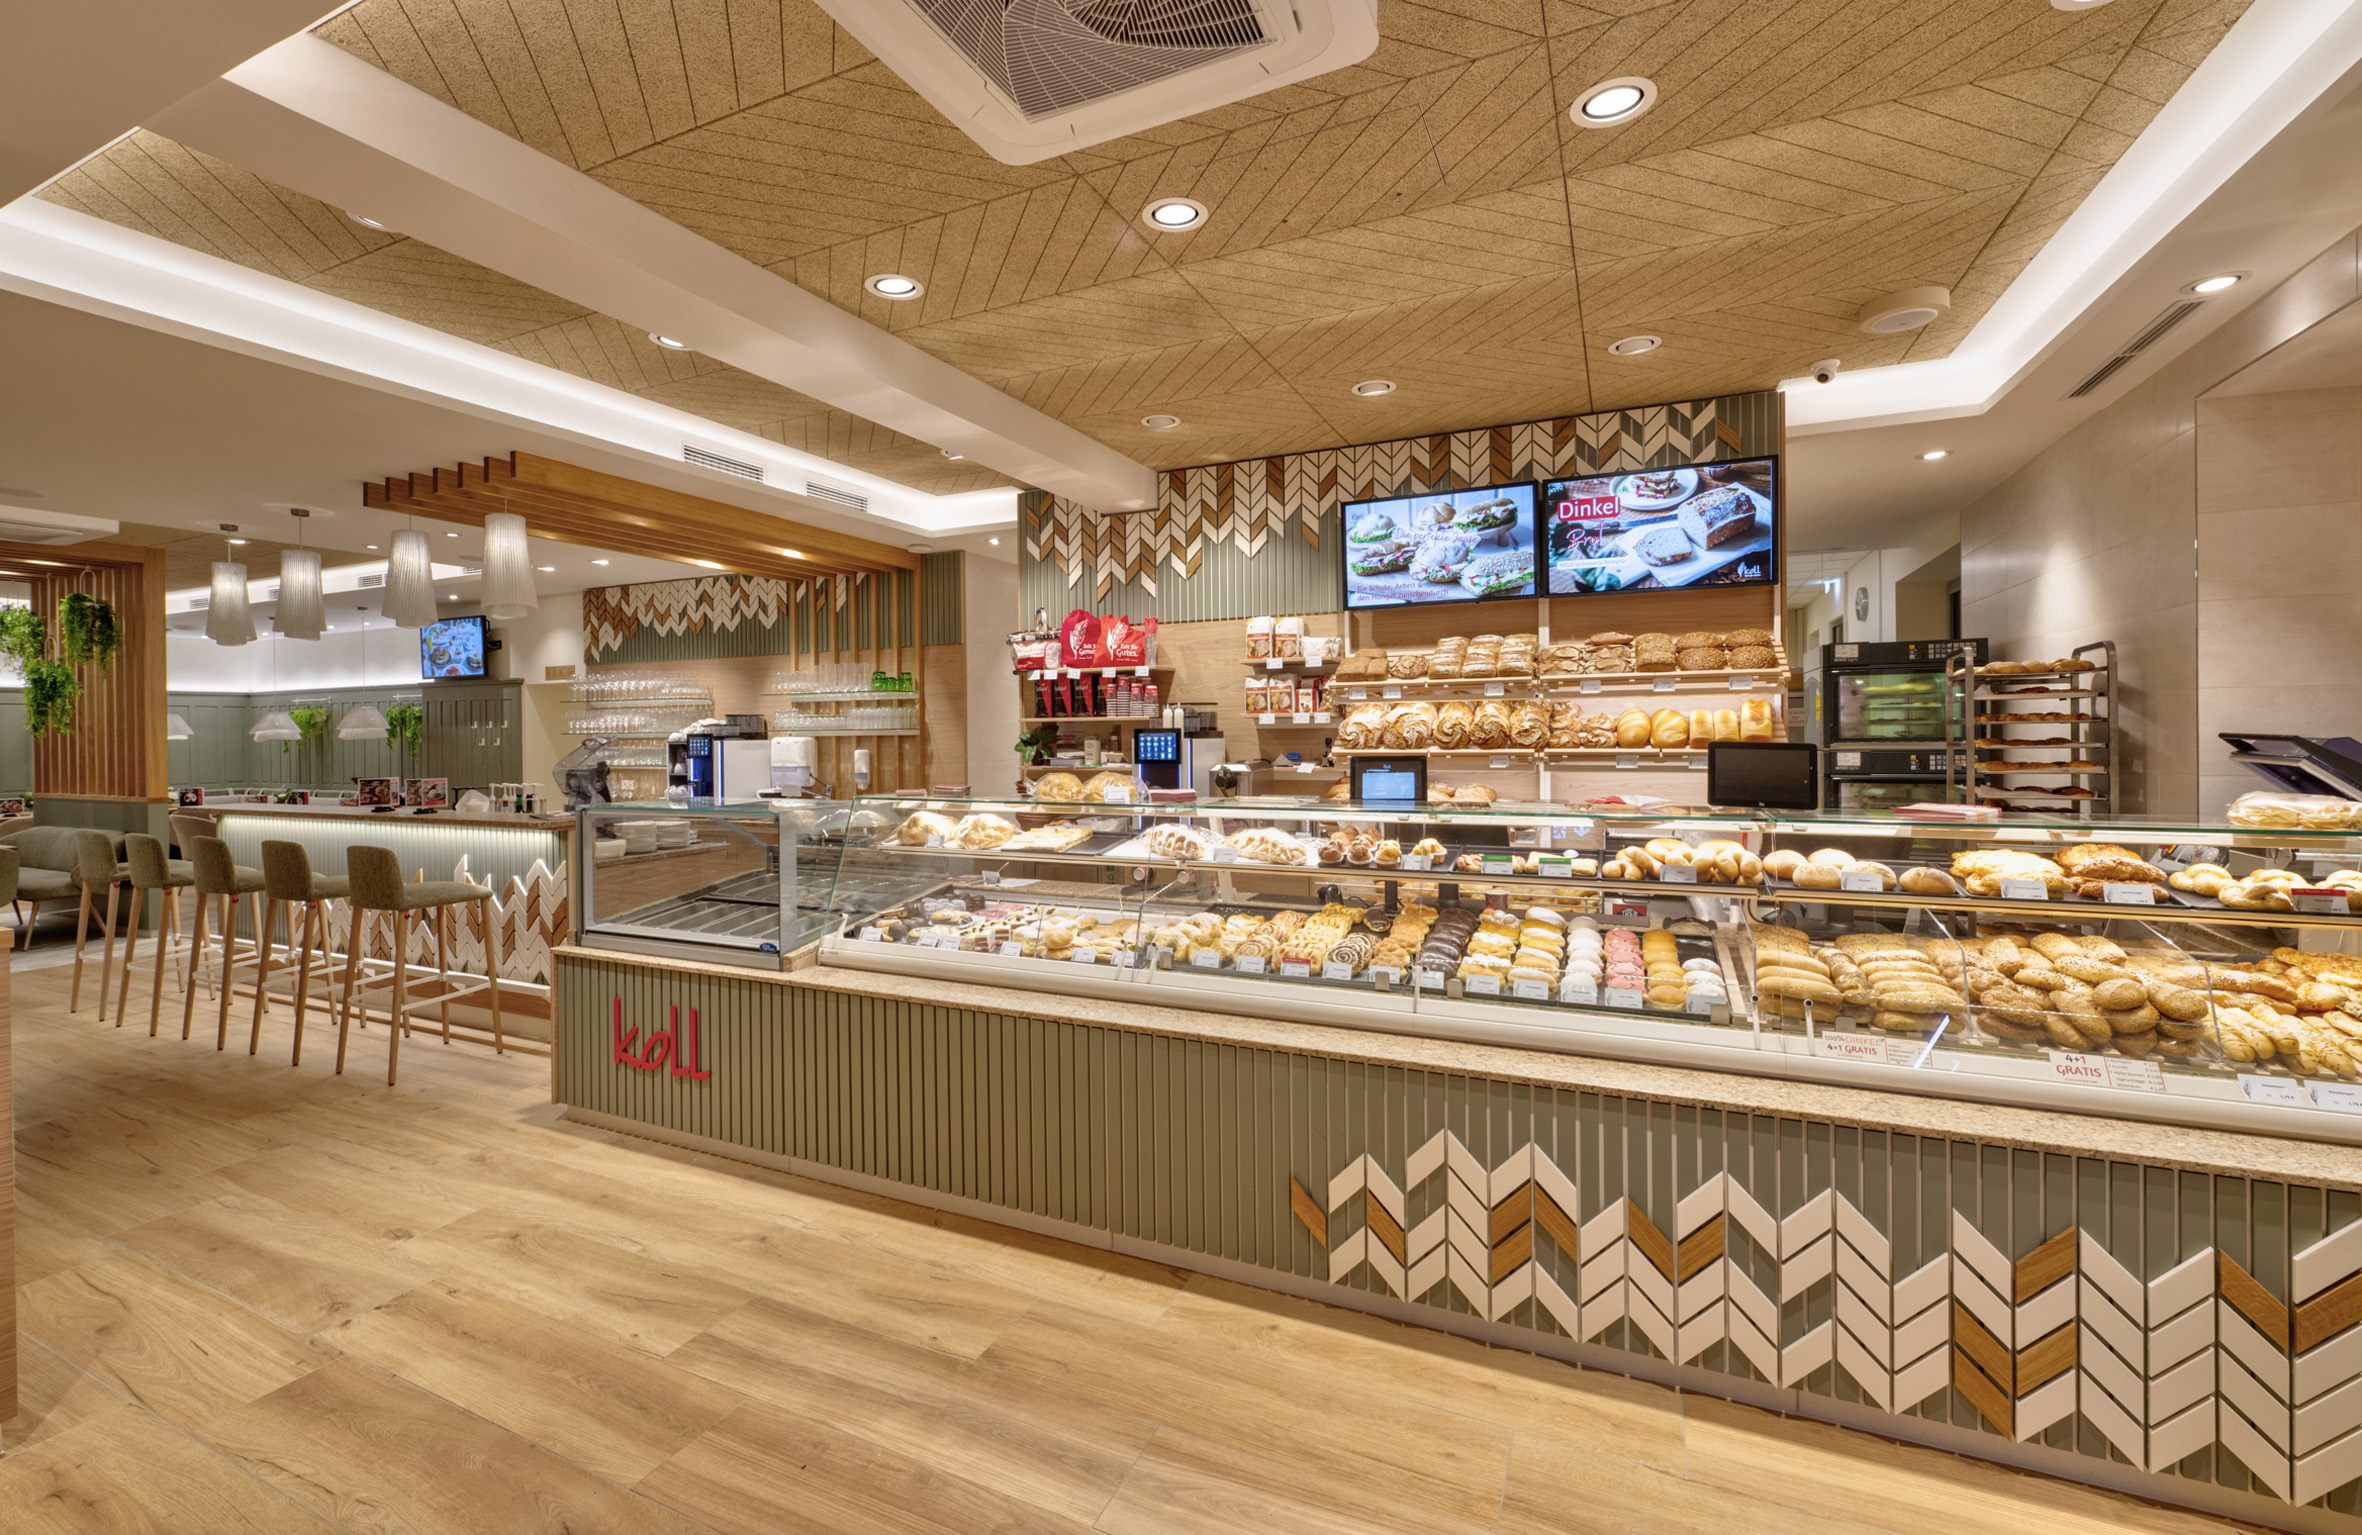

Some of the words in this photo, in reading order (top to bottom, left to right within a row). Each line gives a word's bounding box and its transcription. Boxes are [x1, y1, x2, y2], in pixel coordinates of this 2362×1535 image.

[1560, 496, 1619, 519] Dinkel
[1566, 521, 1611, 550] Brot
[1395, 582, 1416, 590] Arbeit
[613, 996, 712, 1080] koll
[1845, 1045, 1878, 1056] GRATIS
[2056, 1064, 2102, 1078] GRATIS
